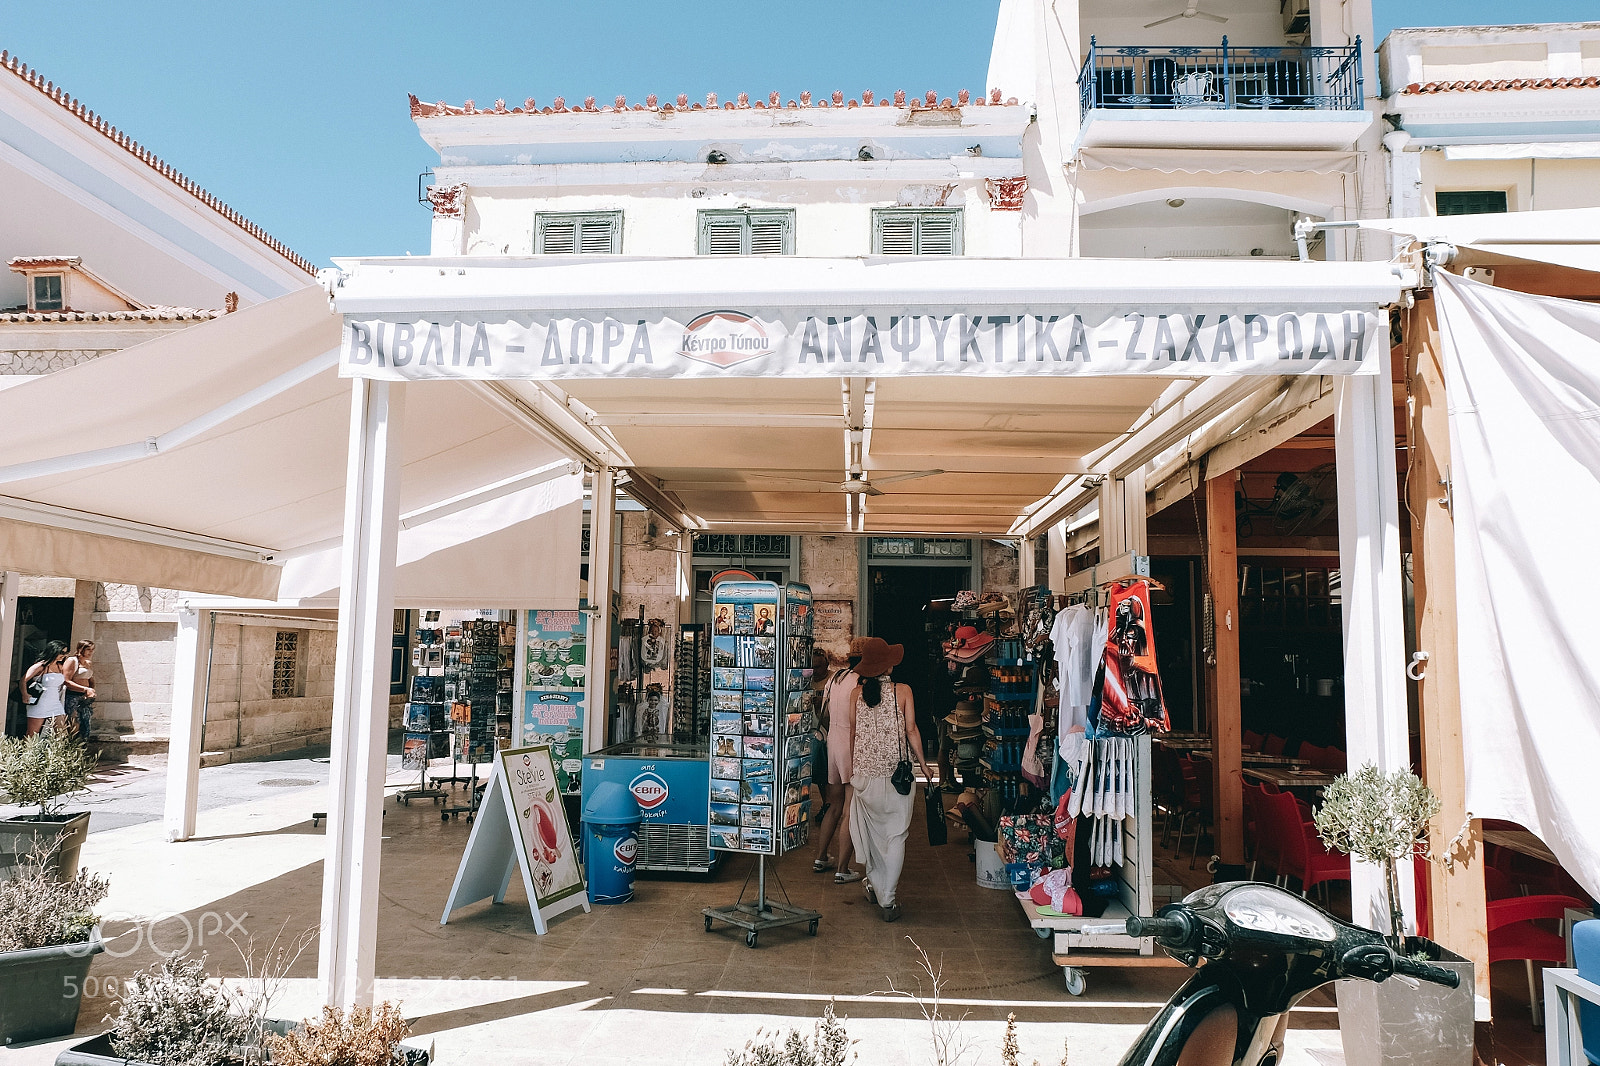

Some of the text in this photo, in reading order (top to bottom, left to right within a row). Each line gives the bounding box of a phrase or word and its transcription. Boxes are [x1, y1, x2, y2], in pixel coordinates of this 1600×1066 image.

[349, 322, 492, 367] ΒΙΒΛΙΑ
[540, 318, 653, 366] ΔΩΡΑ
[682, 333, 769, 354] Κέντρο Τύπου
